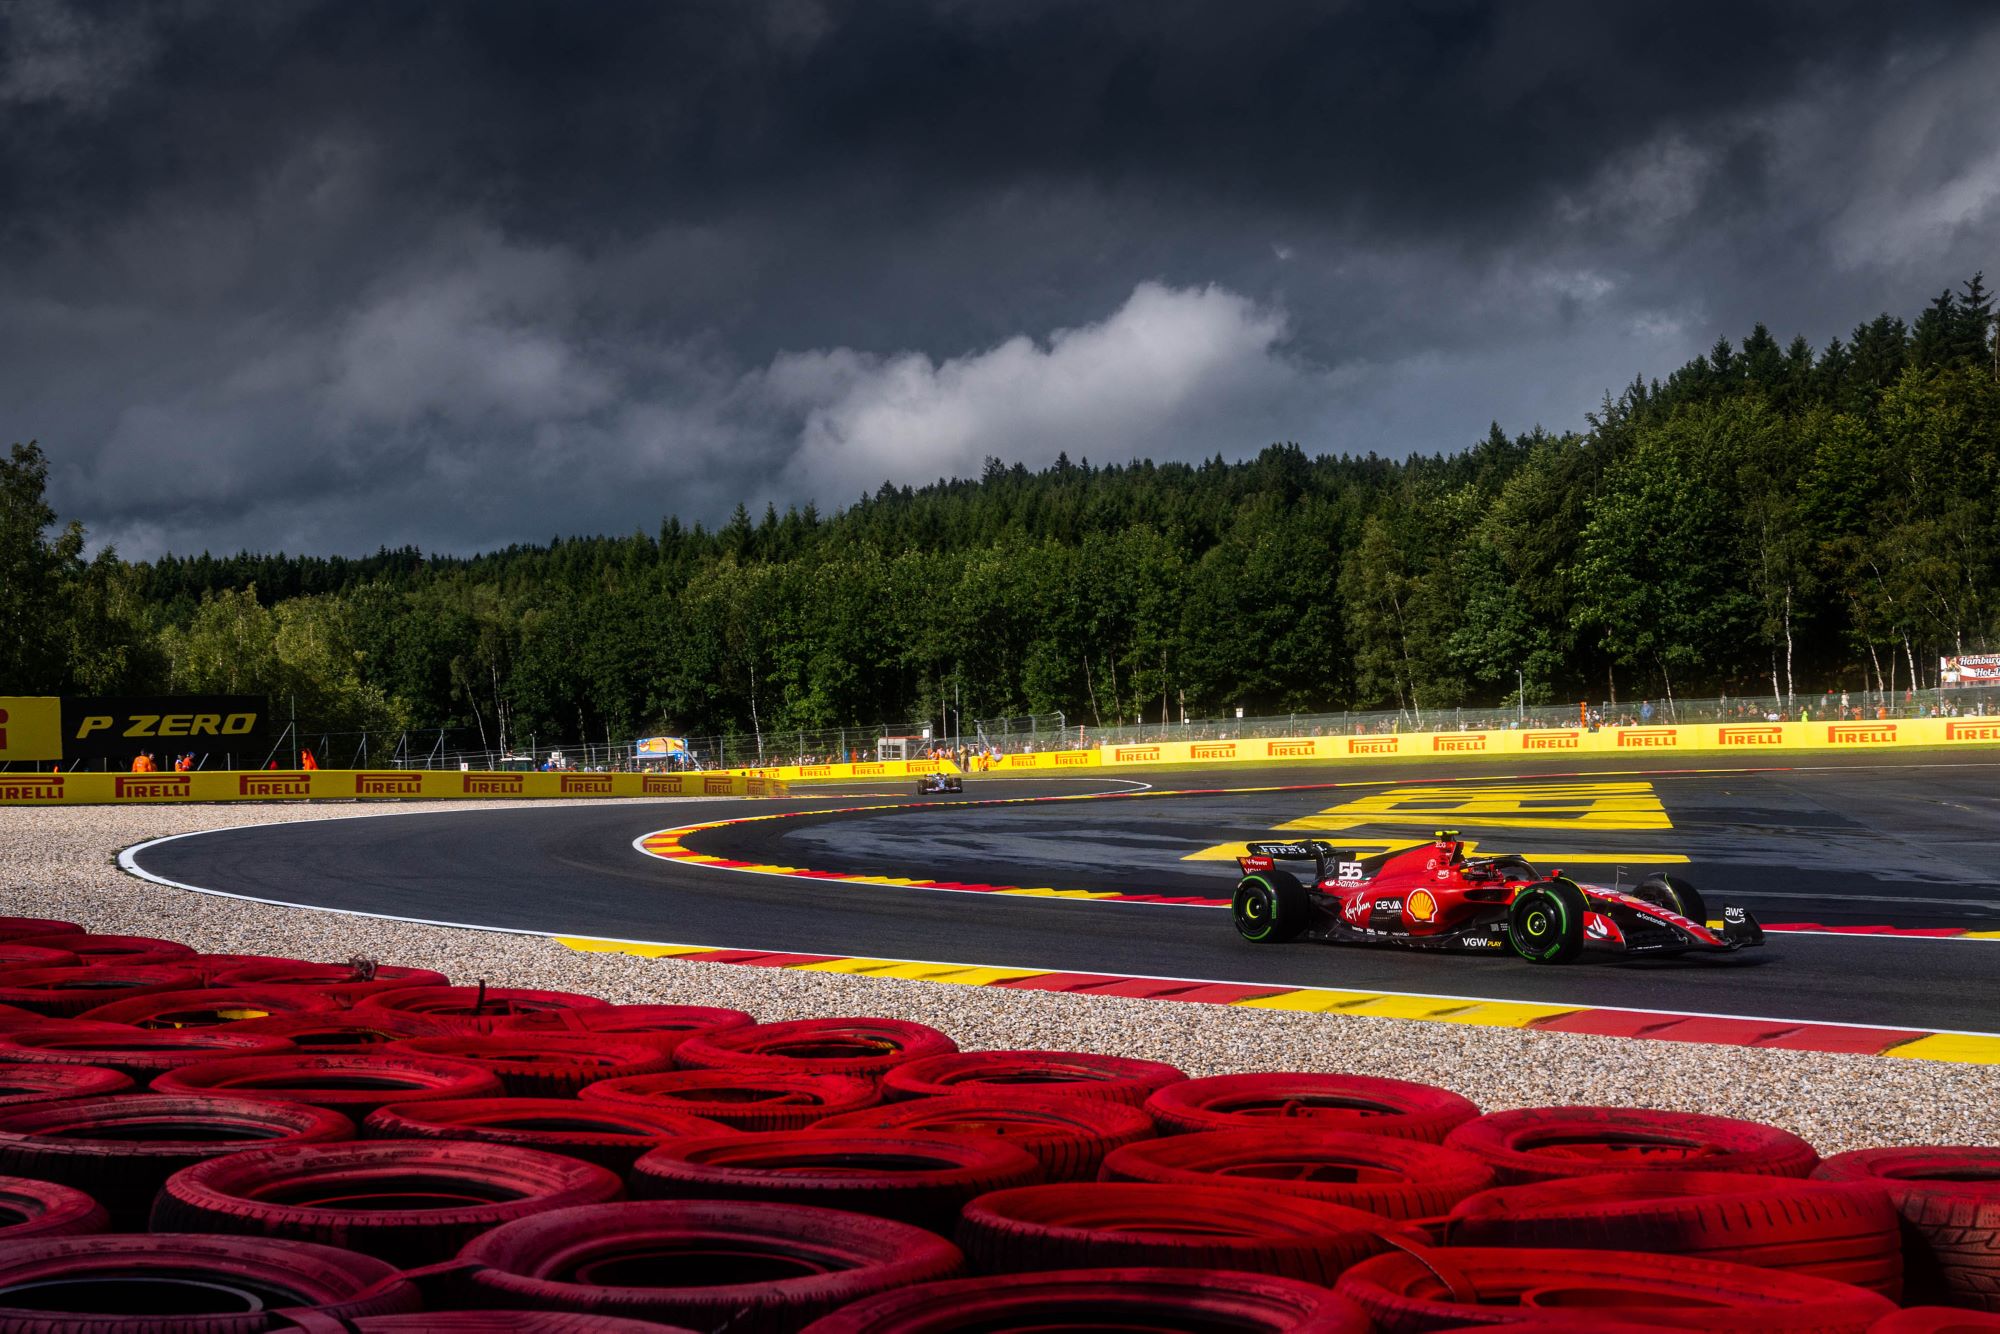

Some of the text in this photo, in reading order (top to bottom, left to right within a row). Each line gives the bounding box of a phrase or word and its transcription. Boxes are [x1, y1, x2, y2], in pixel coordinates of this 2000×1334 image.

[76, 713, 257, 739] P ZERO
[1828, 724, 1897, 743] PIRELLI
[1433, 735, 1486, 751] PIRELLI
[1522, 732, 1579, 749] PIRELLI
[1617, 729, 1677, 746] PIRELLI
[1719, 727, 1783, 745] PIRELLI
[1190, 743, 1236, 759] PIRELLI
[1267, 741, 1315, 756] PIRELLI
[1349, 738, 1398, 753] PIRELLI
[1012, 755, 1036, 767] PIRELLI
[1055, 753, 1088, 765] PIRELLI
[1115, 747, 1160, 761] PIRELLI
[800, 766, 831, 777] PIRELLI
[852, 764, 885, 775] PIRELLI
[906, 761, 940, 773] PIRELLI
[115, 776, 191, 798] PIRELLI
[239, 774, 311, 795] PIRELLI
[356, 774, 422, 793] PIRELLI
[463, 774, 524, 793] PIRELLI
[561, 775, 613, 793] PIRELLI
[643, 775, 682, 793] PIRELLI
[704, 778, 732, 794] PIRELLI
[1339, 862, 1362, 880] 55
[1725, 906, 1745, 917] aws
[1462, 937, 1488, 946] VGW
